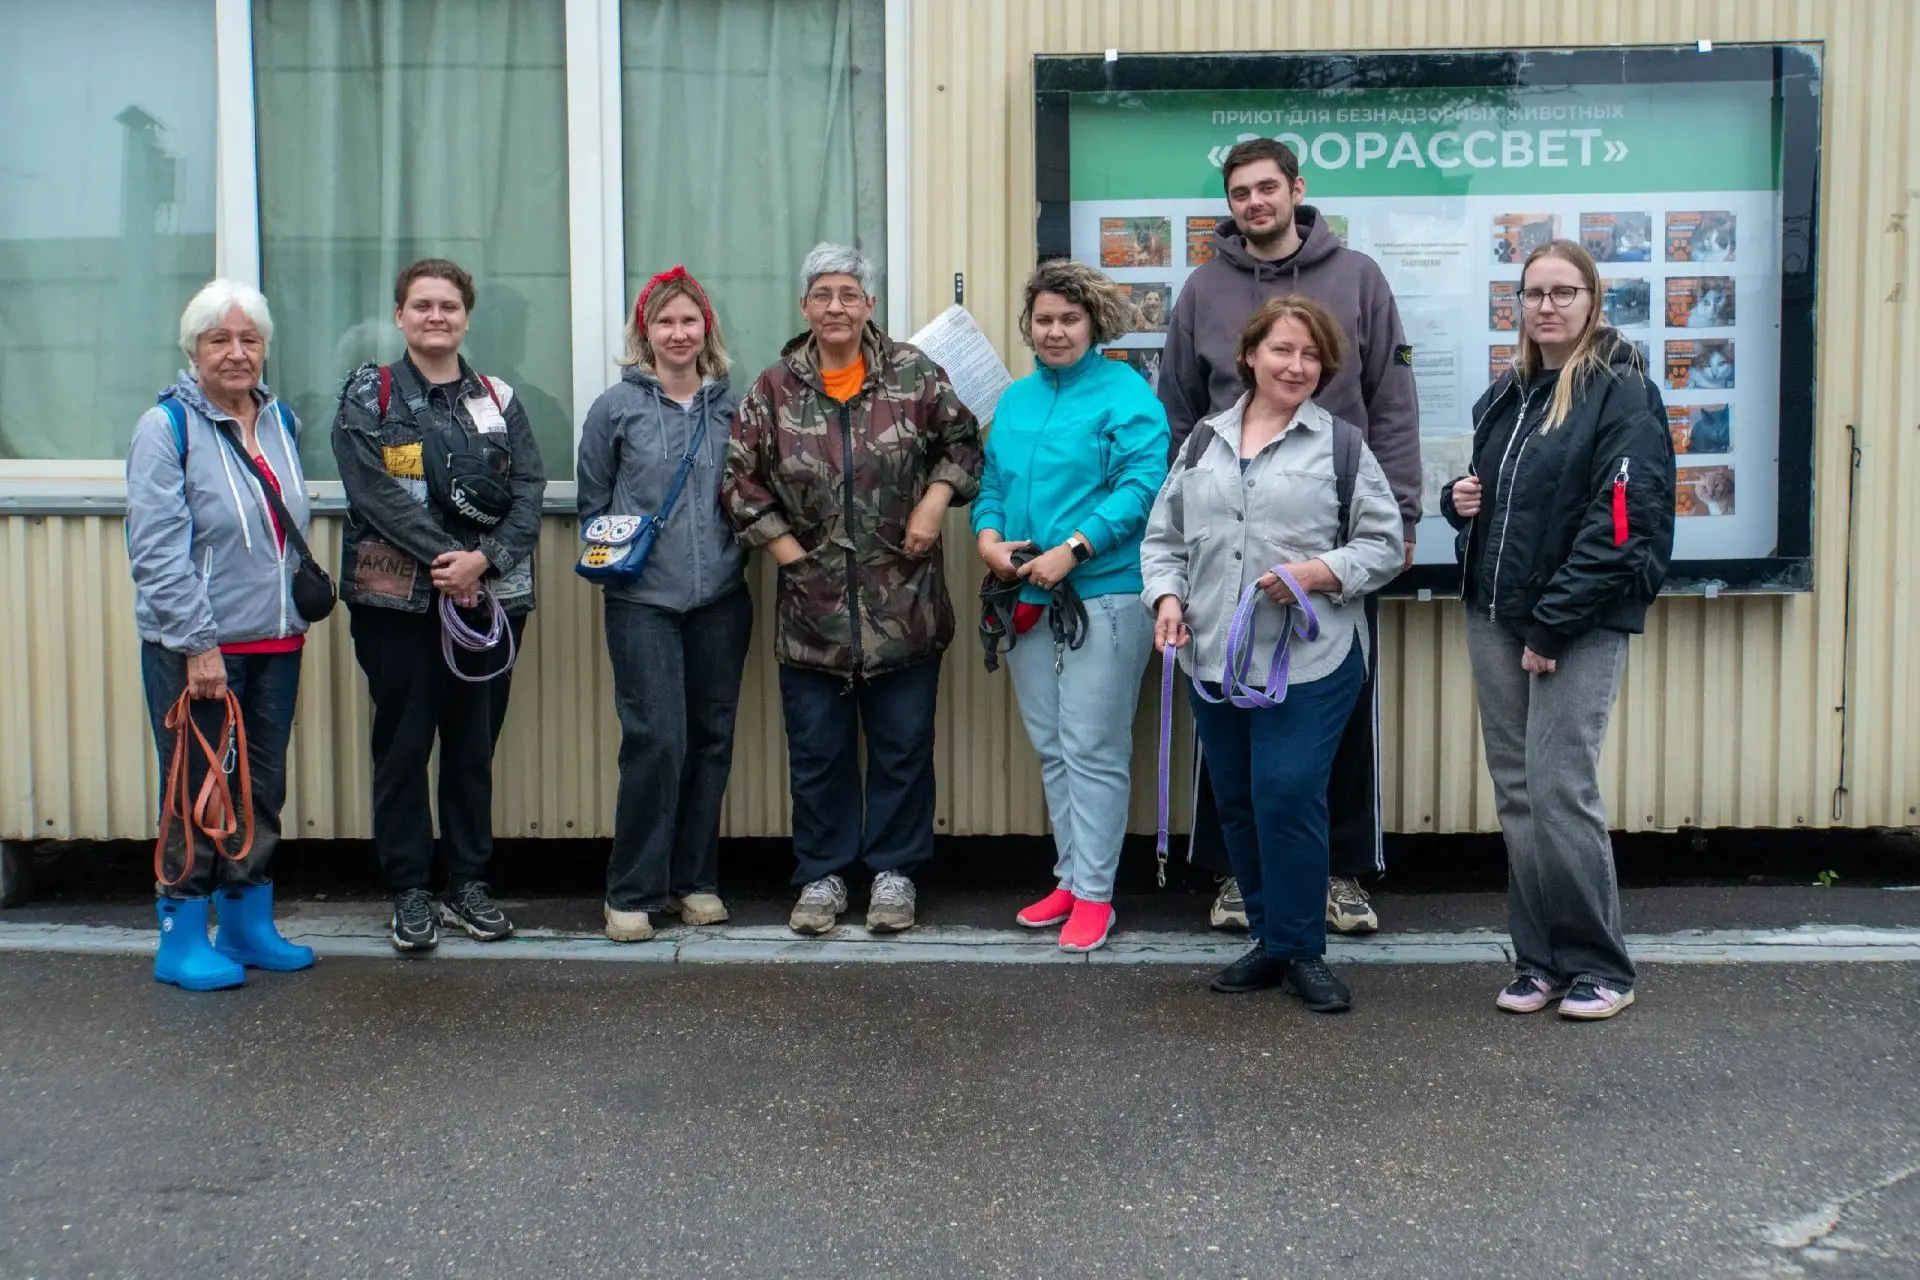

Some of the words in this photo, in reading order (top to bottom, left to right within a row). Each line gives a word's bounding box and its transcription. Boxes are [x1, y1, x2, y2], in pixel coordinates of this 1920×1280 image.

[1212, 110, 1284, 125] ПРИЮТ
[1289, 109, 1330, 126] ДЛЯ
[1336, 105, 1500, 124] БЕЗНАДЗОРНЫХ
[1506, 104, 1625, 121] ЖИВОТНЫХ
